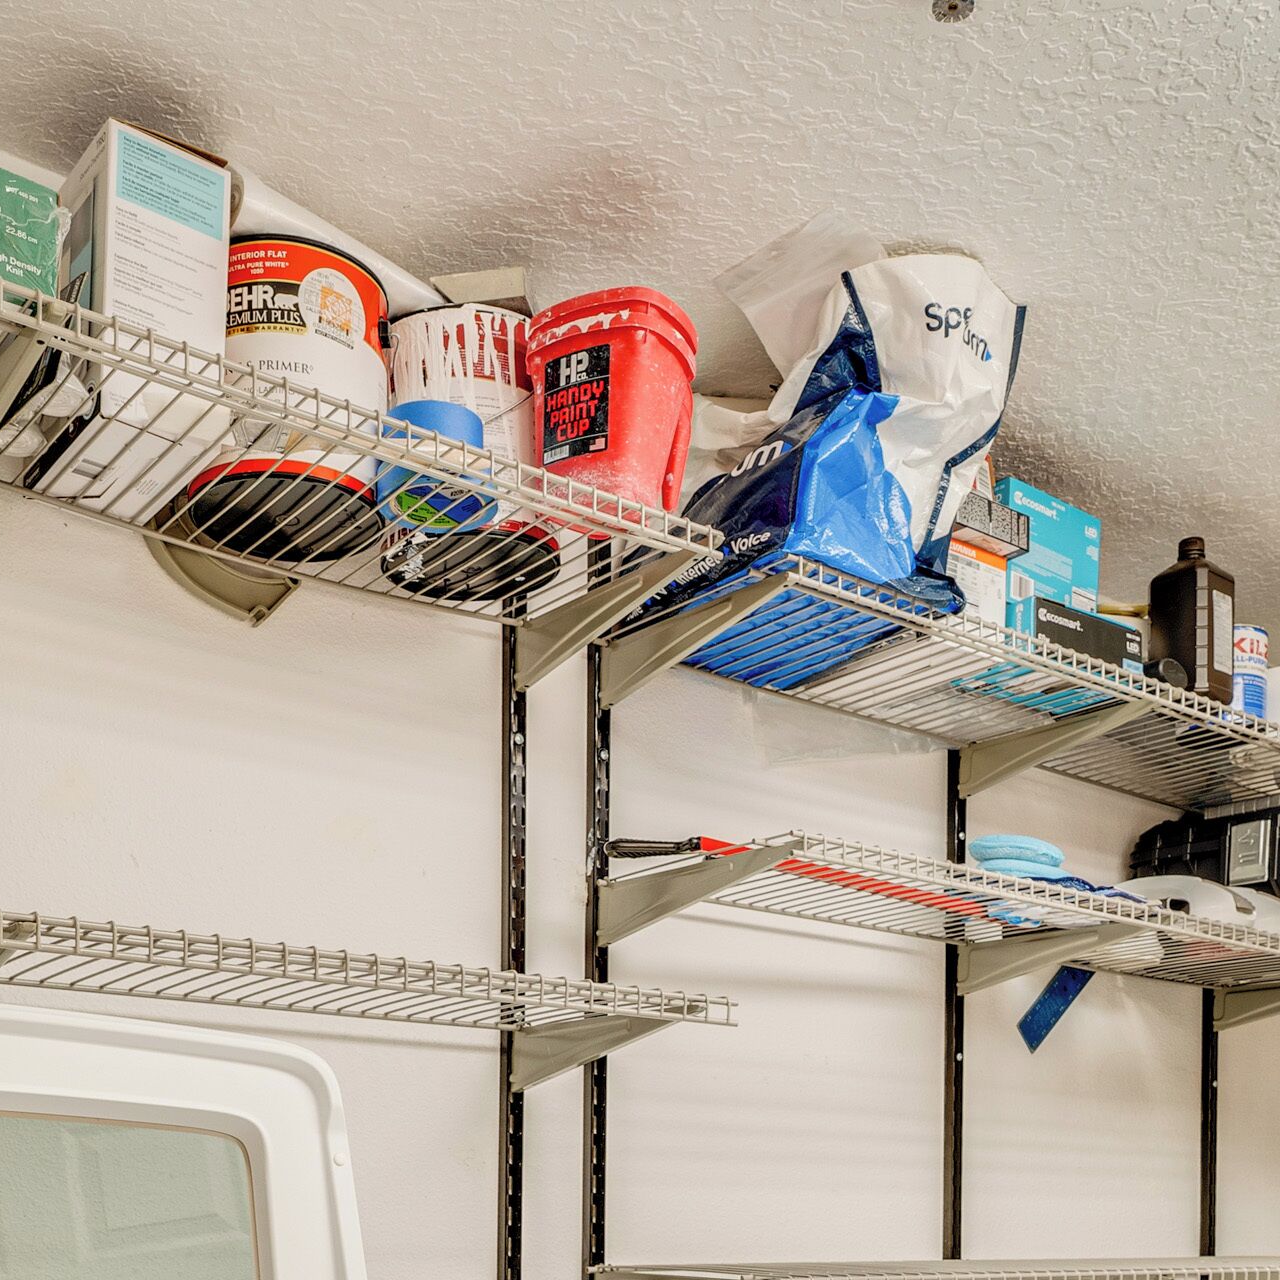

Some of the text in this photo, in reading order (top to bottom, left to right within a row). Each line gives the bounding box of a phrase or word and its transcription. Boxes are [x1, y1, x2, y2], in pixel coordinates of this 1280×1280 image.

[6, 226, 38, 244] 22.86 cm
[229, 250, 288, 262] INTERIOR FLAT
[6, 265, 24, 277] Knit
[10, 256, 42, 276] Density
[259, 360, 311, 375] PRIMER
[546, 380, 605, 412] HANDY
[550, 400, 598, 428] PAINT
[557, 418, 590, 442] CUP
[1084, 525, 1098, 540] LED
[731, 531, 771, 554] Voice
[1126, 641, 1140, 652] LED
